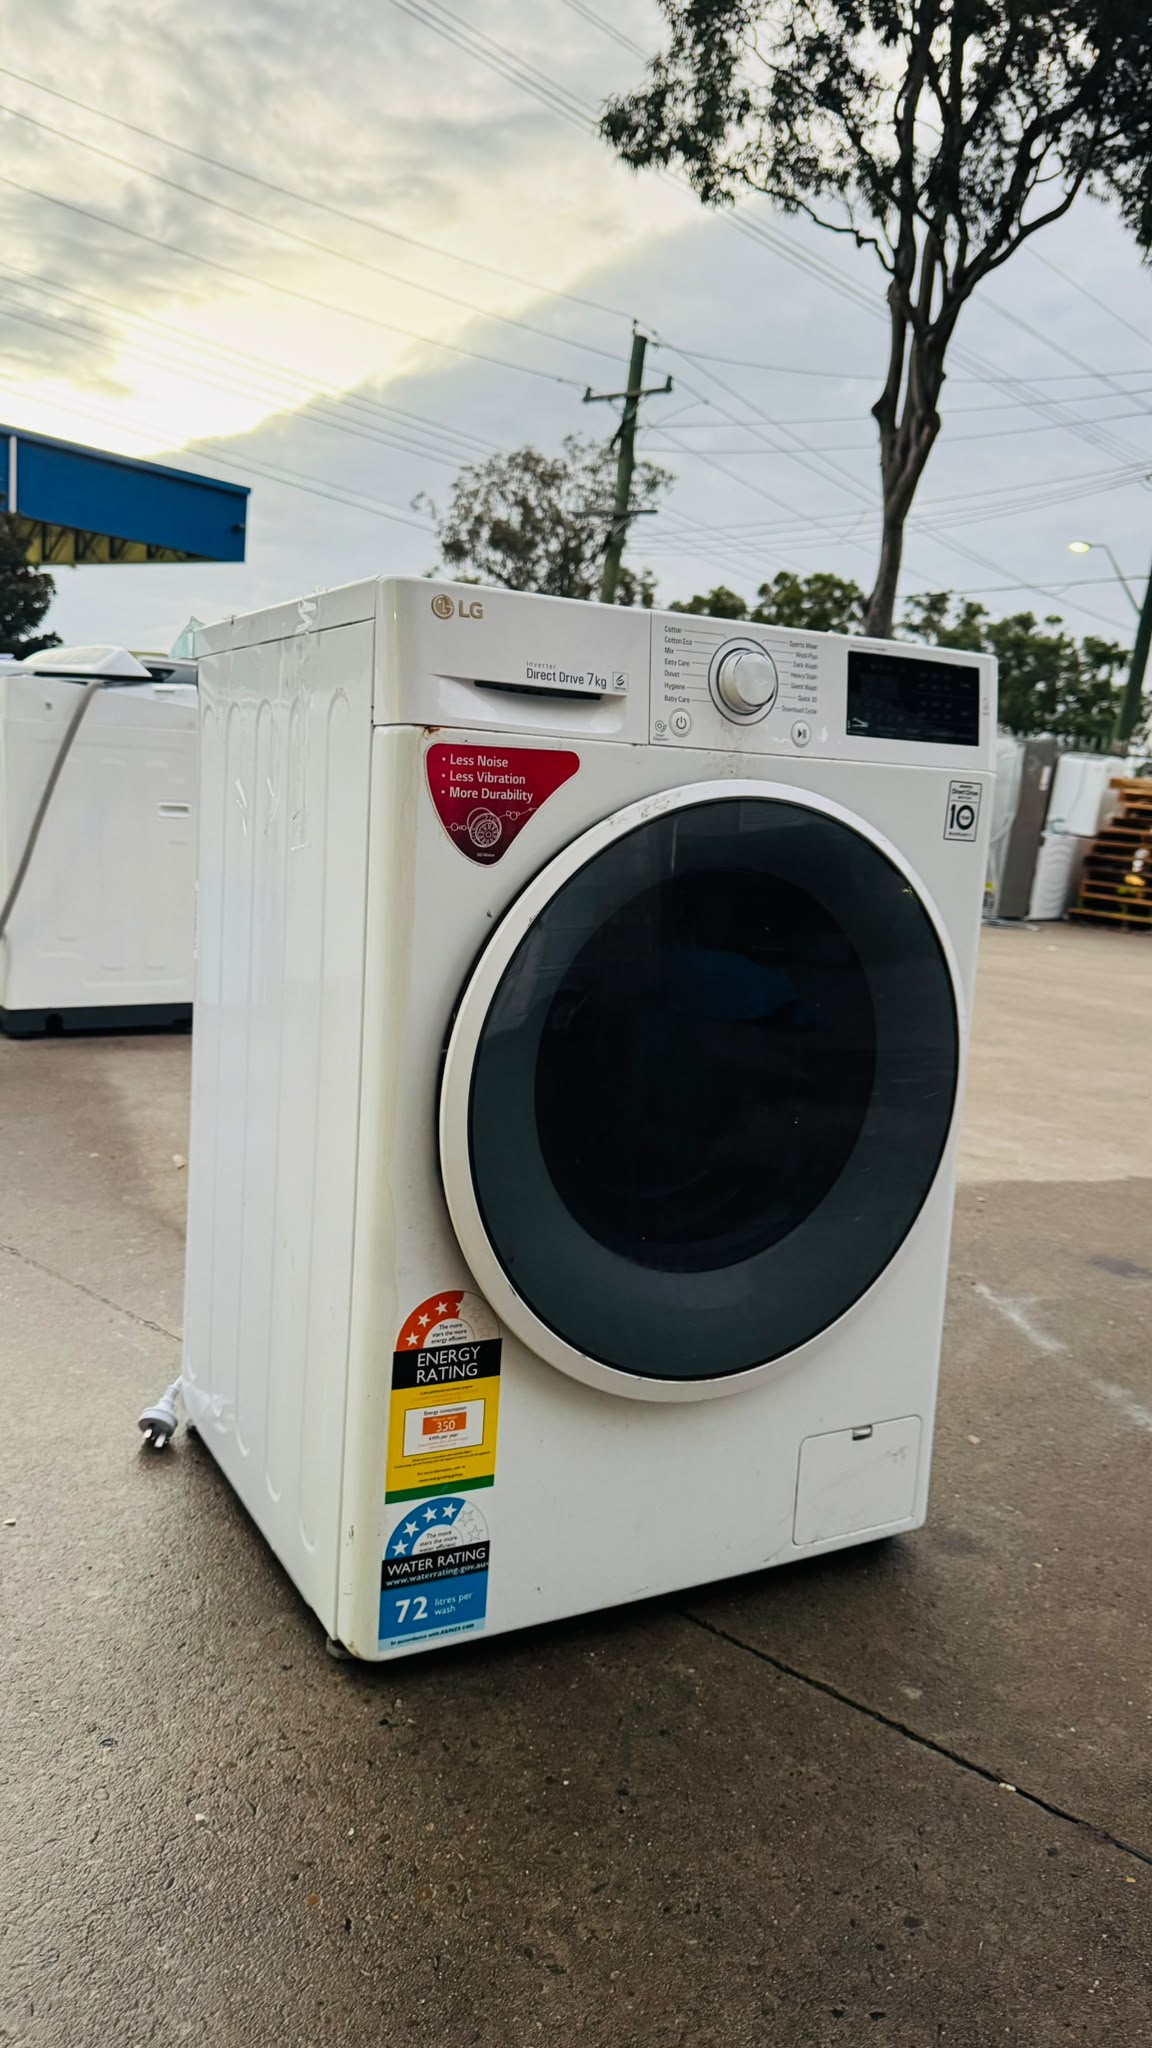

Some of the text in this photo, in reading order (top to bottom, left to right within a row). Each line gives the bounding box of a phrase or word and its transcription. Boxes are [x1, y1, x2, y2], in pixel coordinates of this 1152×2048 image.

[458, 600, 483, 619] LG
[664, 625, 682, 633] Cotton
[664, 636, 682, 644] Cotton
[664, 658, 677, 666] Easy
[526, 668, 556, 682] Direct
[559, 672, 584, 684] Drive
[664, 682, 685, 690] Hygiene
[664, 695, 677, 703] Baby
[450, 753, 508, 768] Less Noise
[450, 770, 526, 784] Less Vibration
[450, 786, 533, 804] More Durability
[950, 804, 975, 830] 10
[417, 1346, 480, 1367] ENERGY
[416, 1362, 478, 1383] RATING
[436, 1420, 455, 1432] 350
[387, 1548, 486, 1576] WATER RATING
[434, 1592, 472, 1606] litres per
[396, 1596, 428, 1623] 72
[434, 1604, 456, 1615] wash
